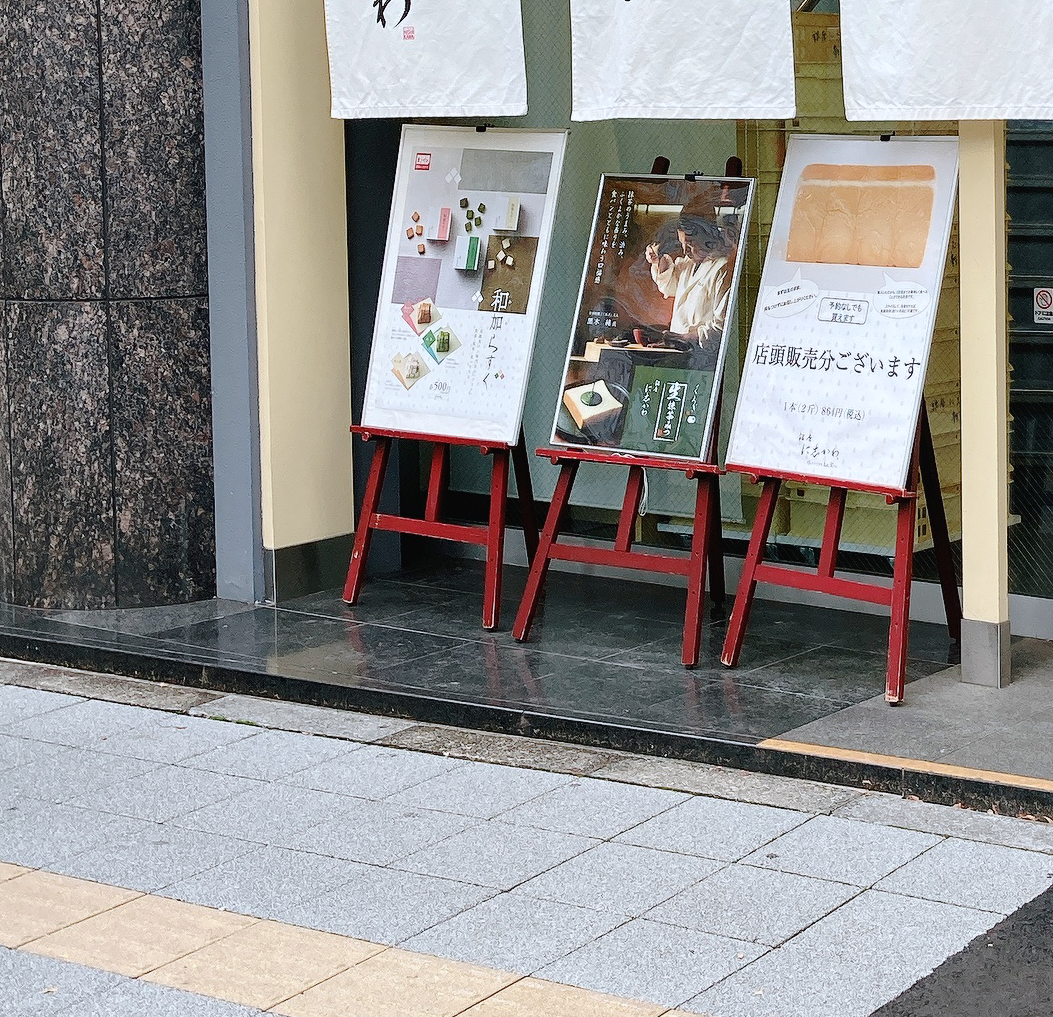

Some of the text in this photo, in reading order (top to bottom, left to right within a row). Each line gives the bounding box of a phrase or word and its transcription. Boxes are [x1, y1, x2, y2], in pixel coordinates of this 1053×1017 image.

[752, 342, 921, 380] 店頭販売分ございます
